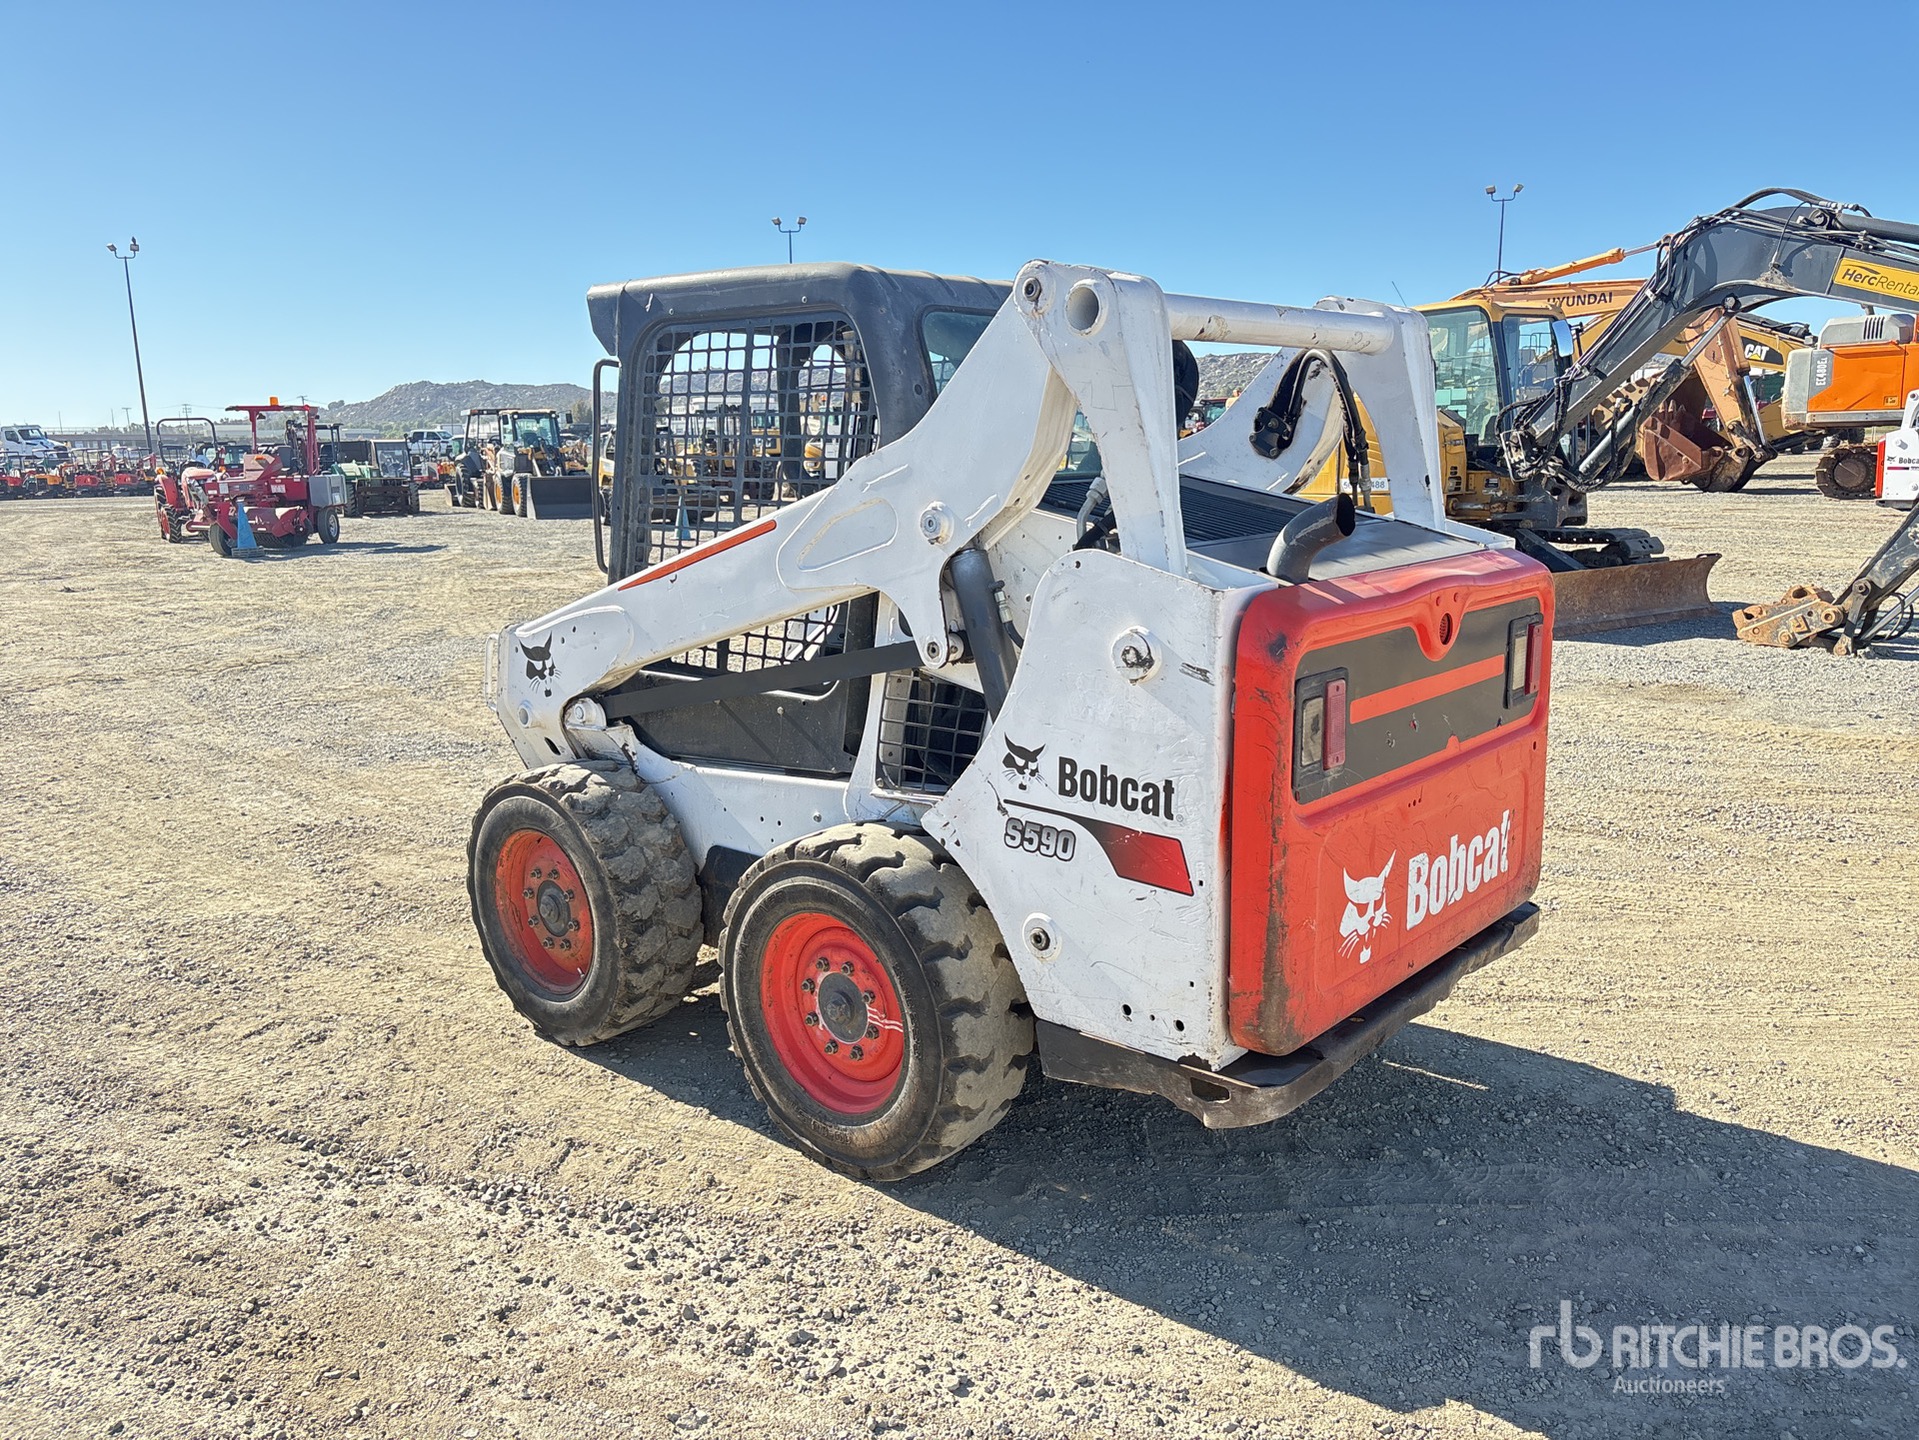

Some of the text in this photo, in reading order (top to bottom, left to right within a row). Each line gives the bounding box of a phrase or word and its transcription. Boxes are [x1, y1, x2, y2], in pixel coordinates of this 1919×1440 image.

[1842, 268, 1919, 297] HercRenta
[1744, 343, 1769, 361] CAT
[1058, 756, 1175, 821] Bobcat
[1003, 816, 1076, 862] S590
[1406, 809, 1510, 931] Bobcat
